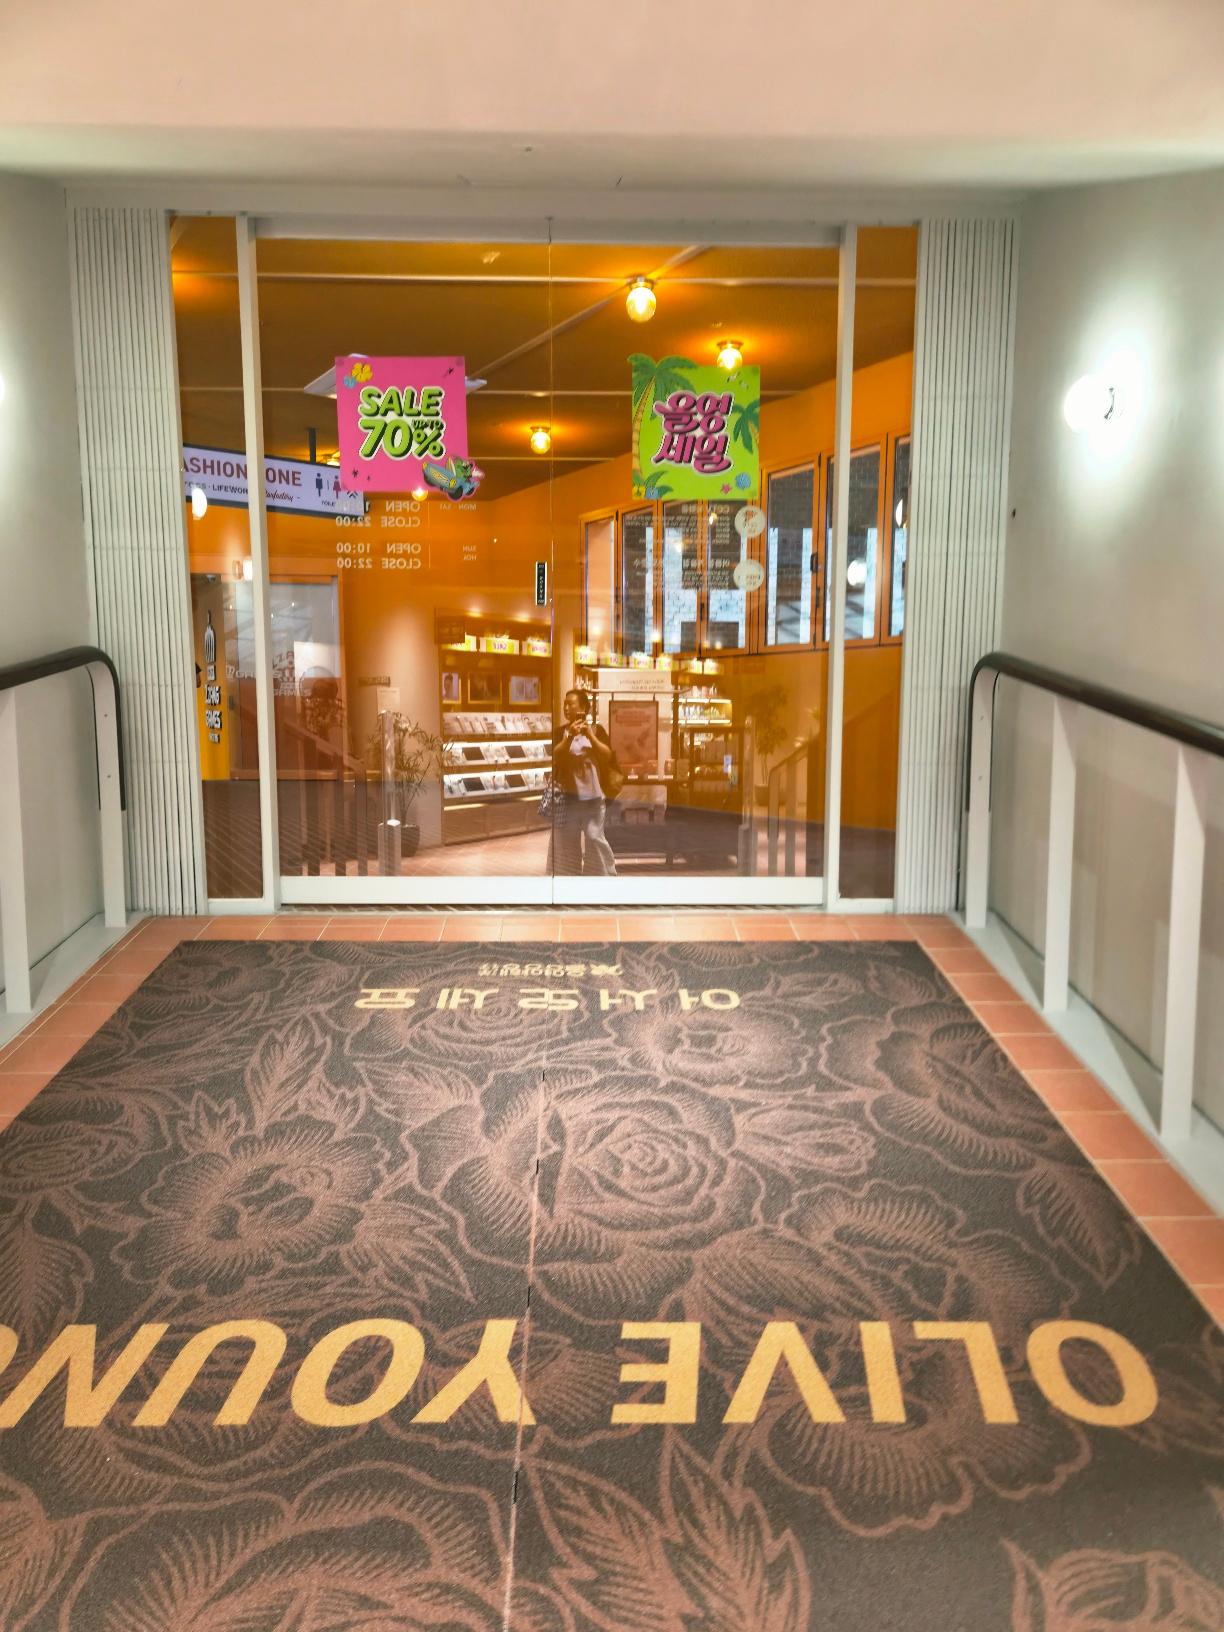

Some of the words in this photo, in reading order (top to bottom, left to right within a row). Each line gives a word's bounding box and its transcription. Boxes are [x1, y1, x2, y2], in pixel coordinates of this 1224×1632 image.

[359, 387, 444, 417] SALE
[654, 391, 735, 434] 올영
[359, 418, 445, 458] 70%
[652, 432, 733, 475] 세일
[182, 456, 248, 481] ASHION
[265, 467, 303, 487] ONE
[212, 484, 249, 495] LIFEWOR
[0, 1318, 537, 1428] YOUN
[610, 1319, 1159, 1428] OLIVE
